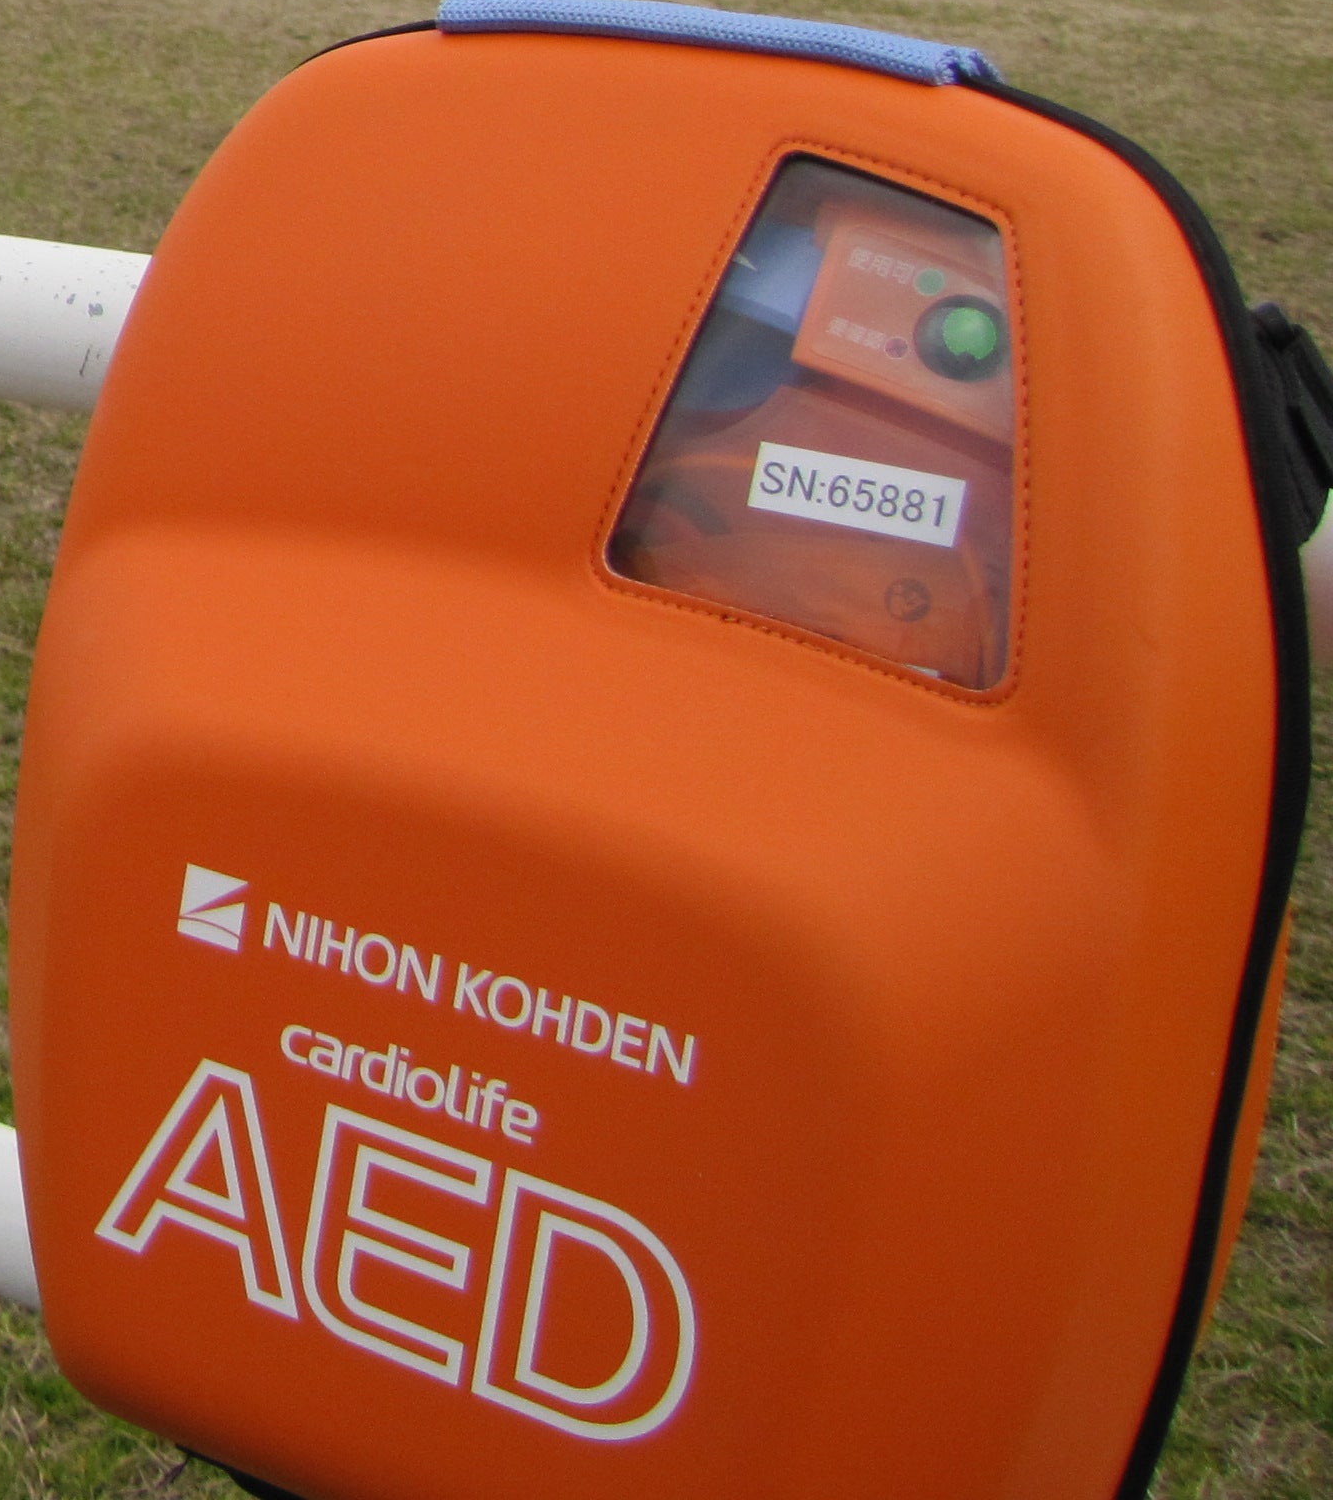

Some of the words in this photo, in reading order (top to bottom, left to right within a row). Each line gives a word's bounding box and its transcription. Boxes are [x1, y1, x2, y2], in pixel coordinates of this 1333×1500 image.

[759, 460, 946, 528] SN:65881
[262, 902, 442, 1003] NIHON
[453, 962, 696, 1086] KOHDEN
[279, 1024, 540, 1145] cardiolife
[94, 1057, 697, 1442] AED
